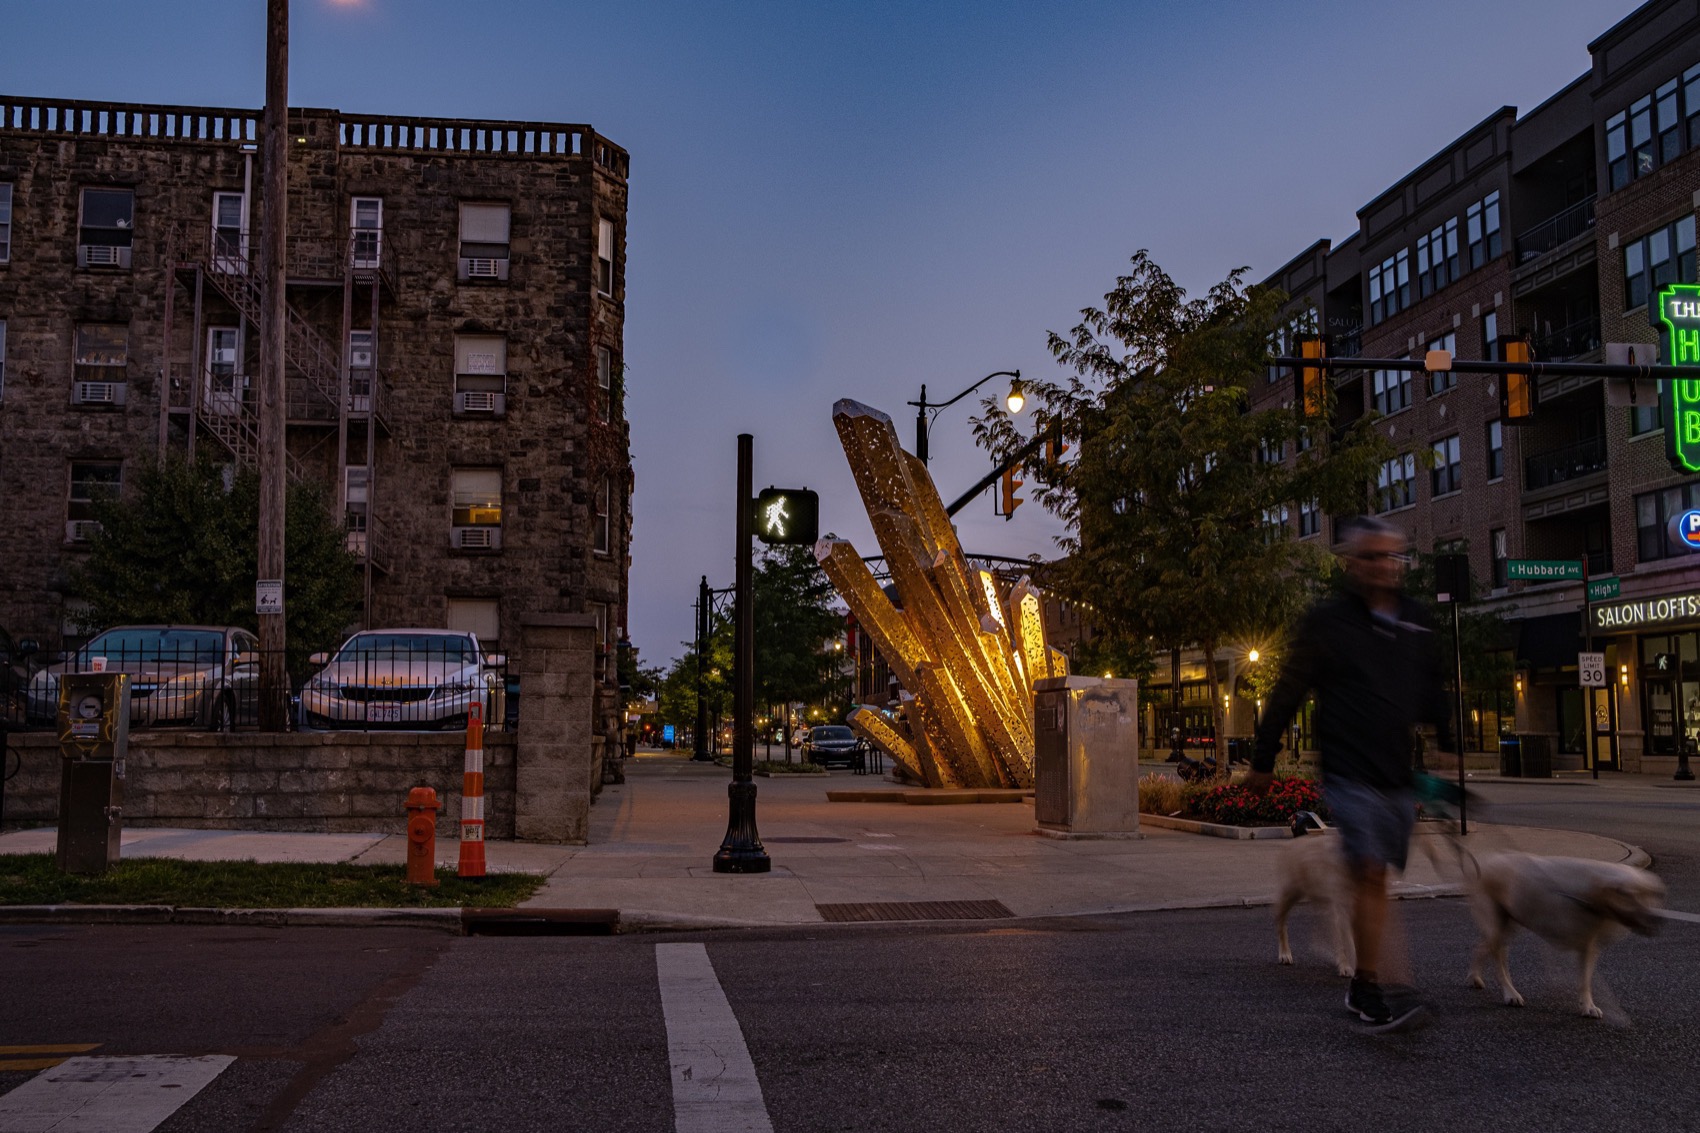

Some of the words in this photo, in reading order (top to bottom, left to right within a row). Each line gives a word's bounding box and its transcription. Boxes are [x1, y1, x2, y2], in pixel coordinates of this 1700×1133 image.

[1518, 564, 1565, 576] Hubbard
[1568, 566, 1579, 574] AVE
[1594, 584, 1611, 598] High
[1597, 602, 1644, 627] SALON
[1649, 596, 1697, 620] LOFTS
[1583, 670, 1602, 682] 30
